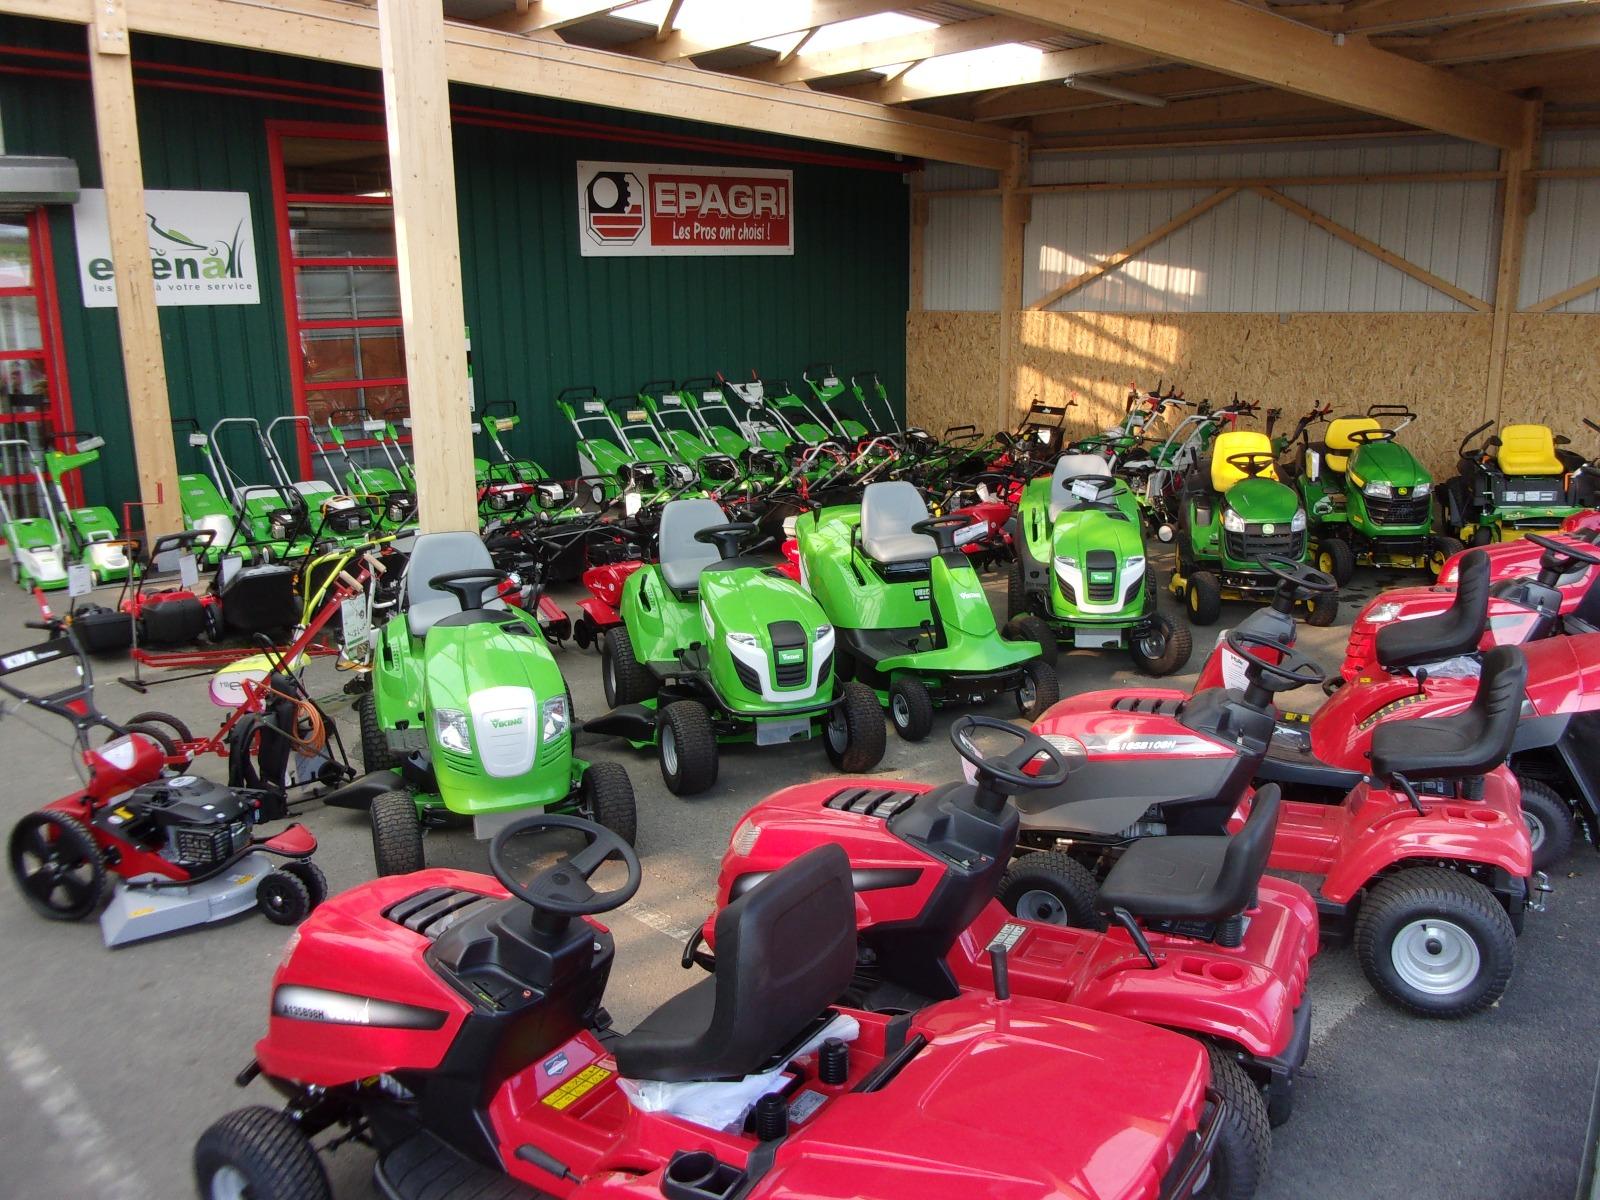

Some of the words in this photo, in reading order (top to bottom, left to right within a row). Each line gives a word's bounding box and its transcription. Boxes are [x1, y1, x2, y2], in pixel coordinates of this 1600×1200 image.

[653, 182, 786, 220] EPAGRI
[672, 220, 691, 240] Les
[693, 222, 717, 240] Pros
[720, 224, 736, 240] ont
[738, 222, 765, 241] choisi
[94, 283, 113, 292] les
[168, 283, 201, 291] votre
[207, 282, 253, 290] service
